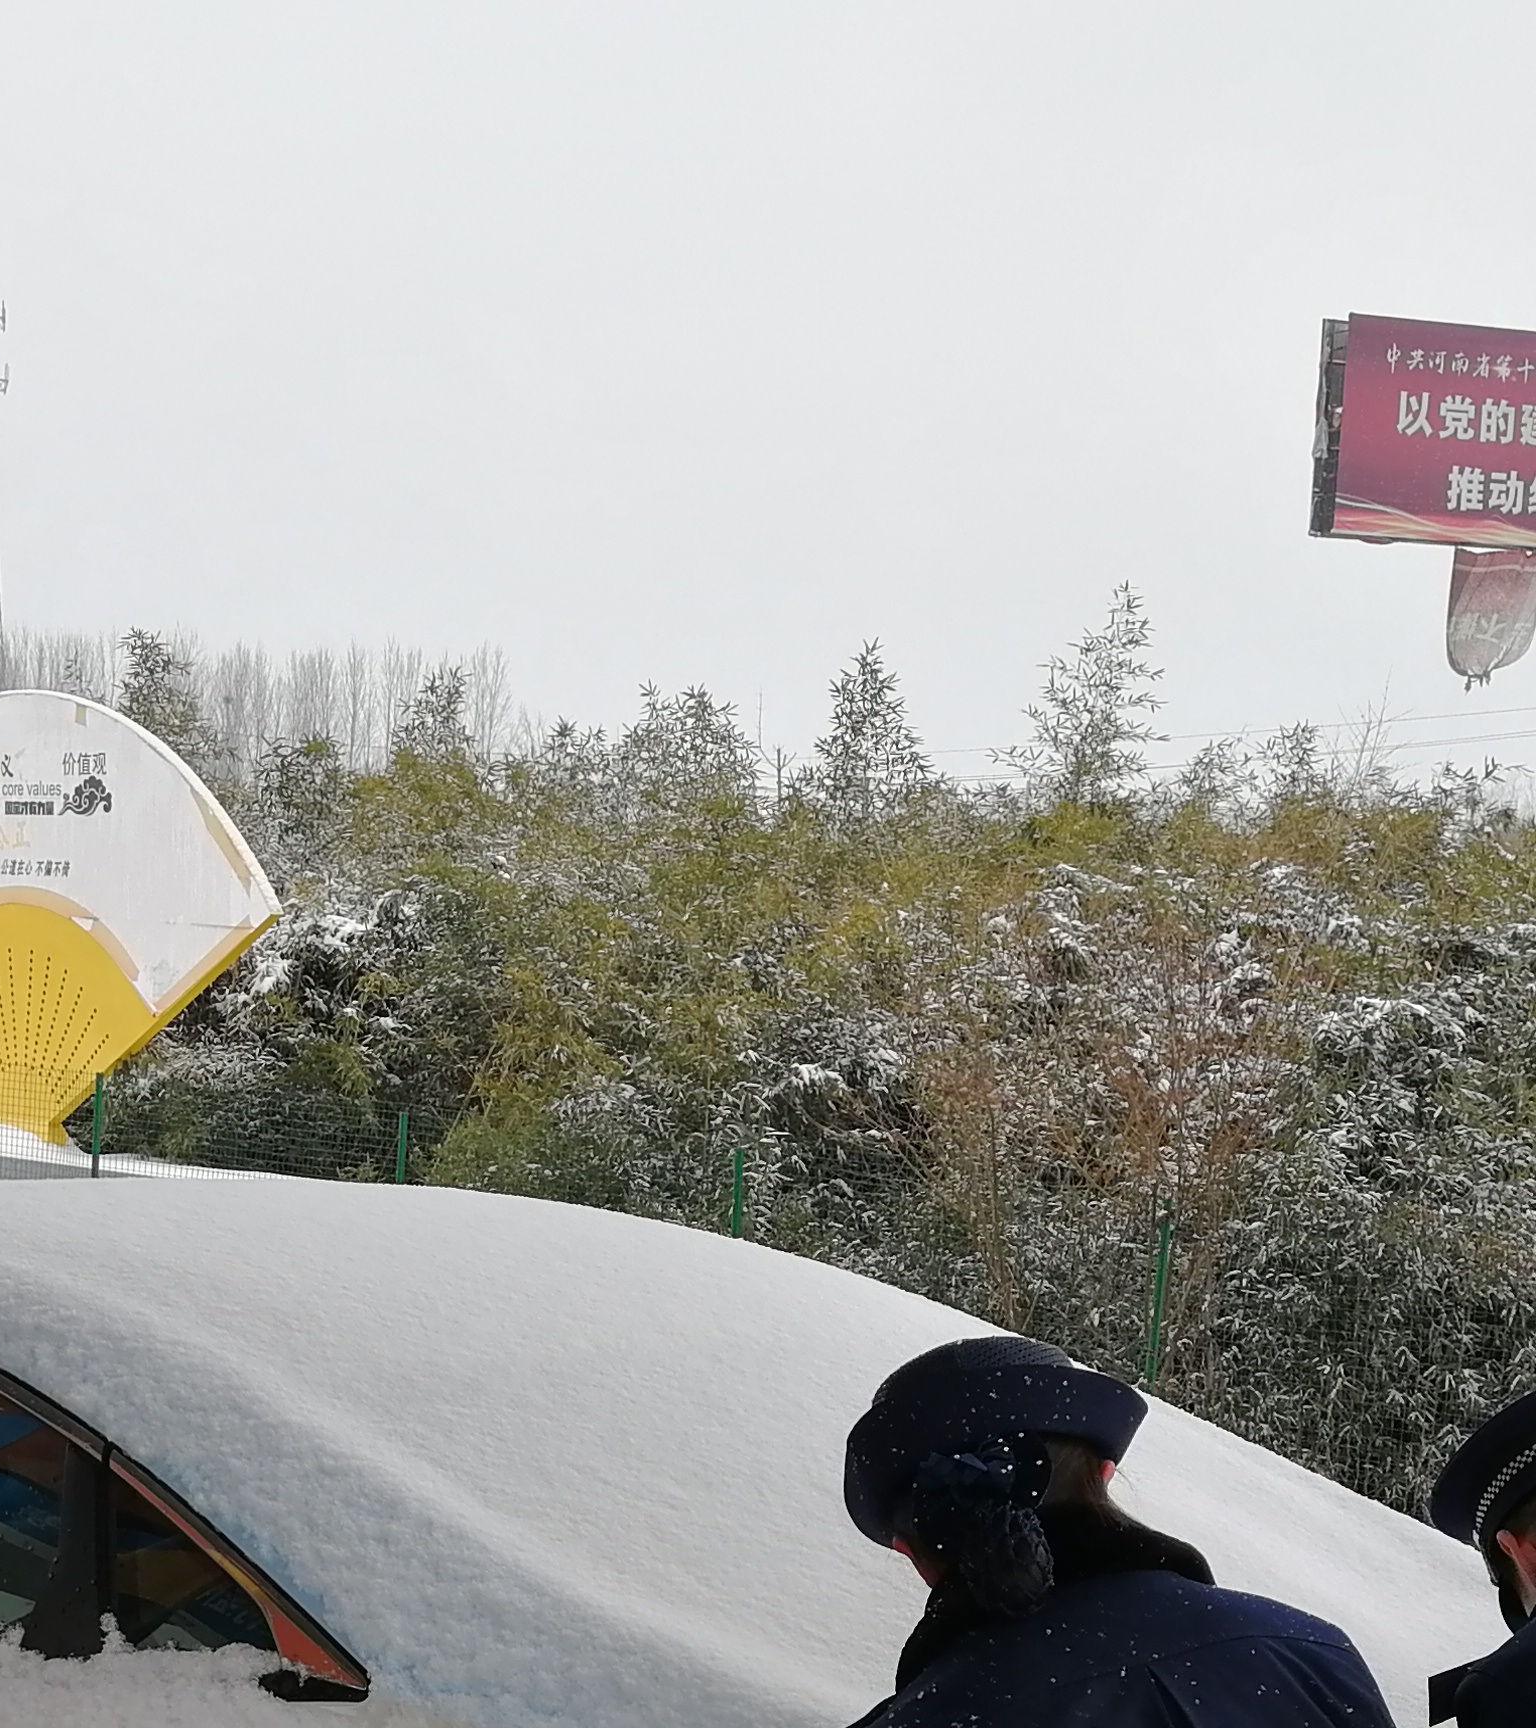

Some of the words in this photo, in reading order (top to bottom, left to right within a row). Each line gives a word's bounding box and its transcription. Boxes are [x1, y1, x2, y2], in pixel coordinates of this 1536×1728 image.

[62, 752, 108, 776] 价值观
[2, 782, 24, 796] core
[26, 779, 62, 797] values
